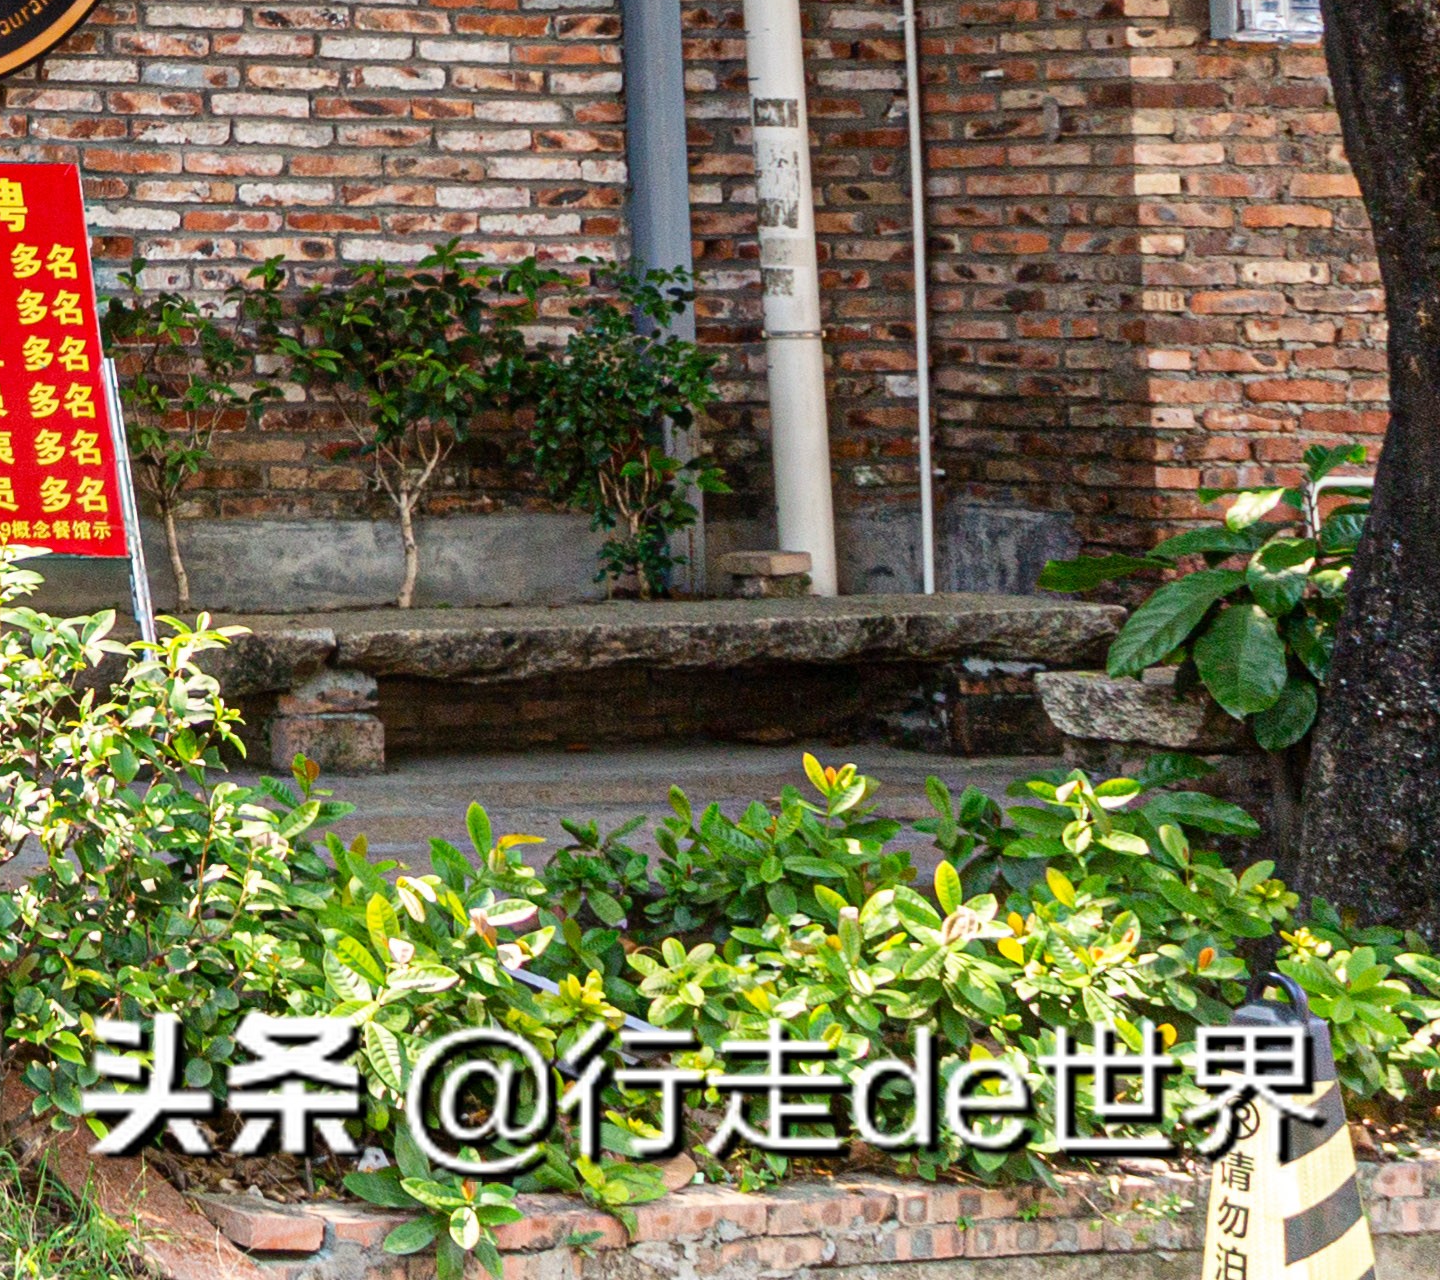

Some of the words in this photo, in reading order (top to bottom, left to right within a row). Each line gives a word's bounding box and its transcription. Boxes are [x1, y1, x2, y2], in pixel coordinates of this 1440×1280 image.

[10, 243, 77, 279] 多名
[16, 289, 84, 326] 多名
[22, 336, 89, 372] 多名
[28, 382, 96, 419] 多名
[34, 429, 102, 466] 多名
[40, 476, 108, 513] 多名
